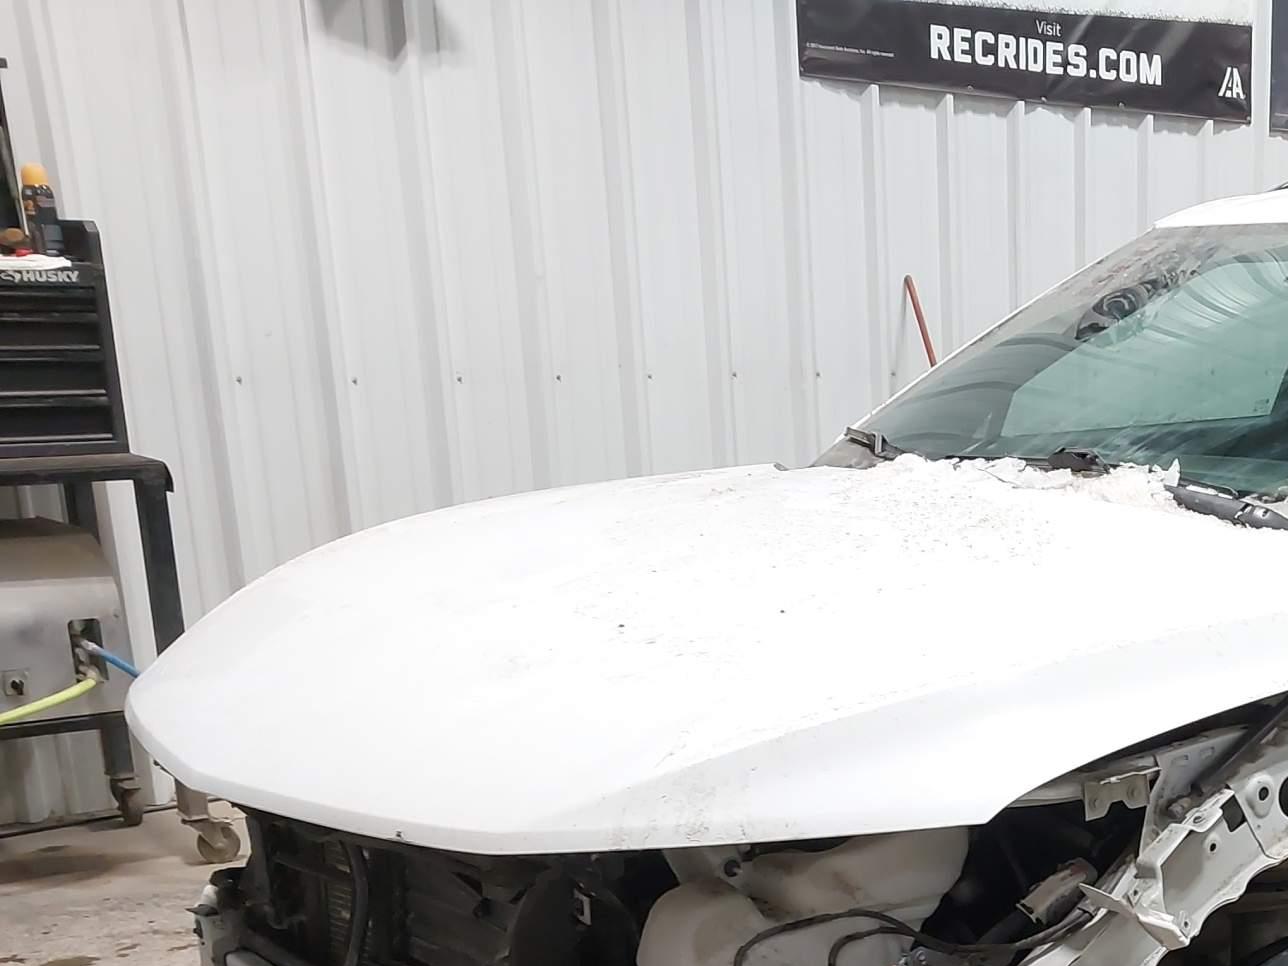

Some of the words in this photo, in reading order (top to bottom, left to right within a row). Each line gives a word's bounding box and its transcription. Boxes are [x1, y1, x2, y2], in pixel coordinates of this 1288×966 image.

[1036, 20, 1061, 37] Visit
[929, 24, 1162, 86] RECRIDES.COM
[22, 270, 79, 282] HUSKY
